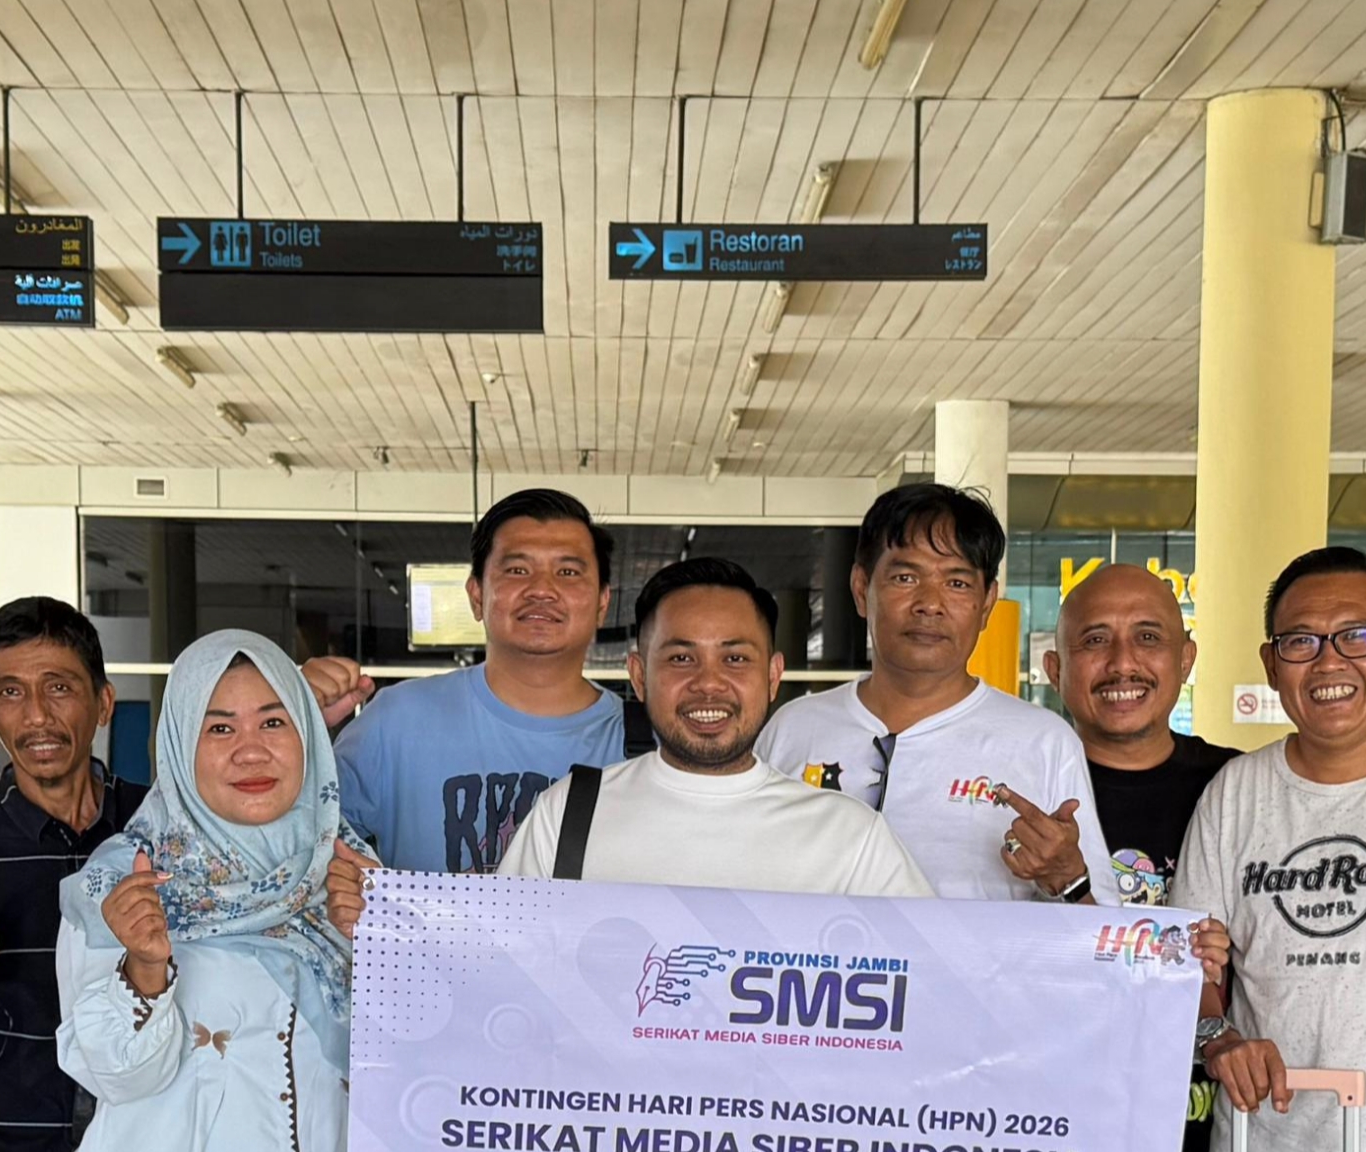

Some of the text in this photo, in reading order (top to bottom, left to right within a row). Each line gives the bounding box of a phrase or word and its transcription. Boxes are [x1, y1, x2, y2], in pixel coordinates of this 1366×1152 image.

[259, 222, 321, 247] Toilet
[710, 230, 804, 253] Restoran
[259, 252, 303, 268] Toilets
[710, 257, 785, 272] Restaurant
[55, 308, 82, 320] ATM
[1242, 857, 1331, 897] Hard
[1296, 900, 1358, 919] HOTEL
[743, 950, 909, 972] PROVINSI JAMBI
[1286, 951, 1361, 967] PENANG
[729, 966, 908, 1032] SMSI
[632, 1026, 904, 1051] SERIKAT MEDIA SIBER INDONESIA
[460, 1085, 1070, 1138] KONTINGEN HARI PERS NASIONAL (HPN) 2026
